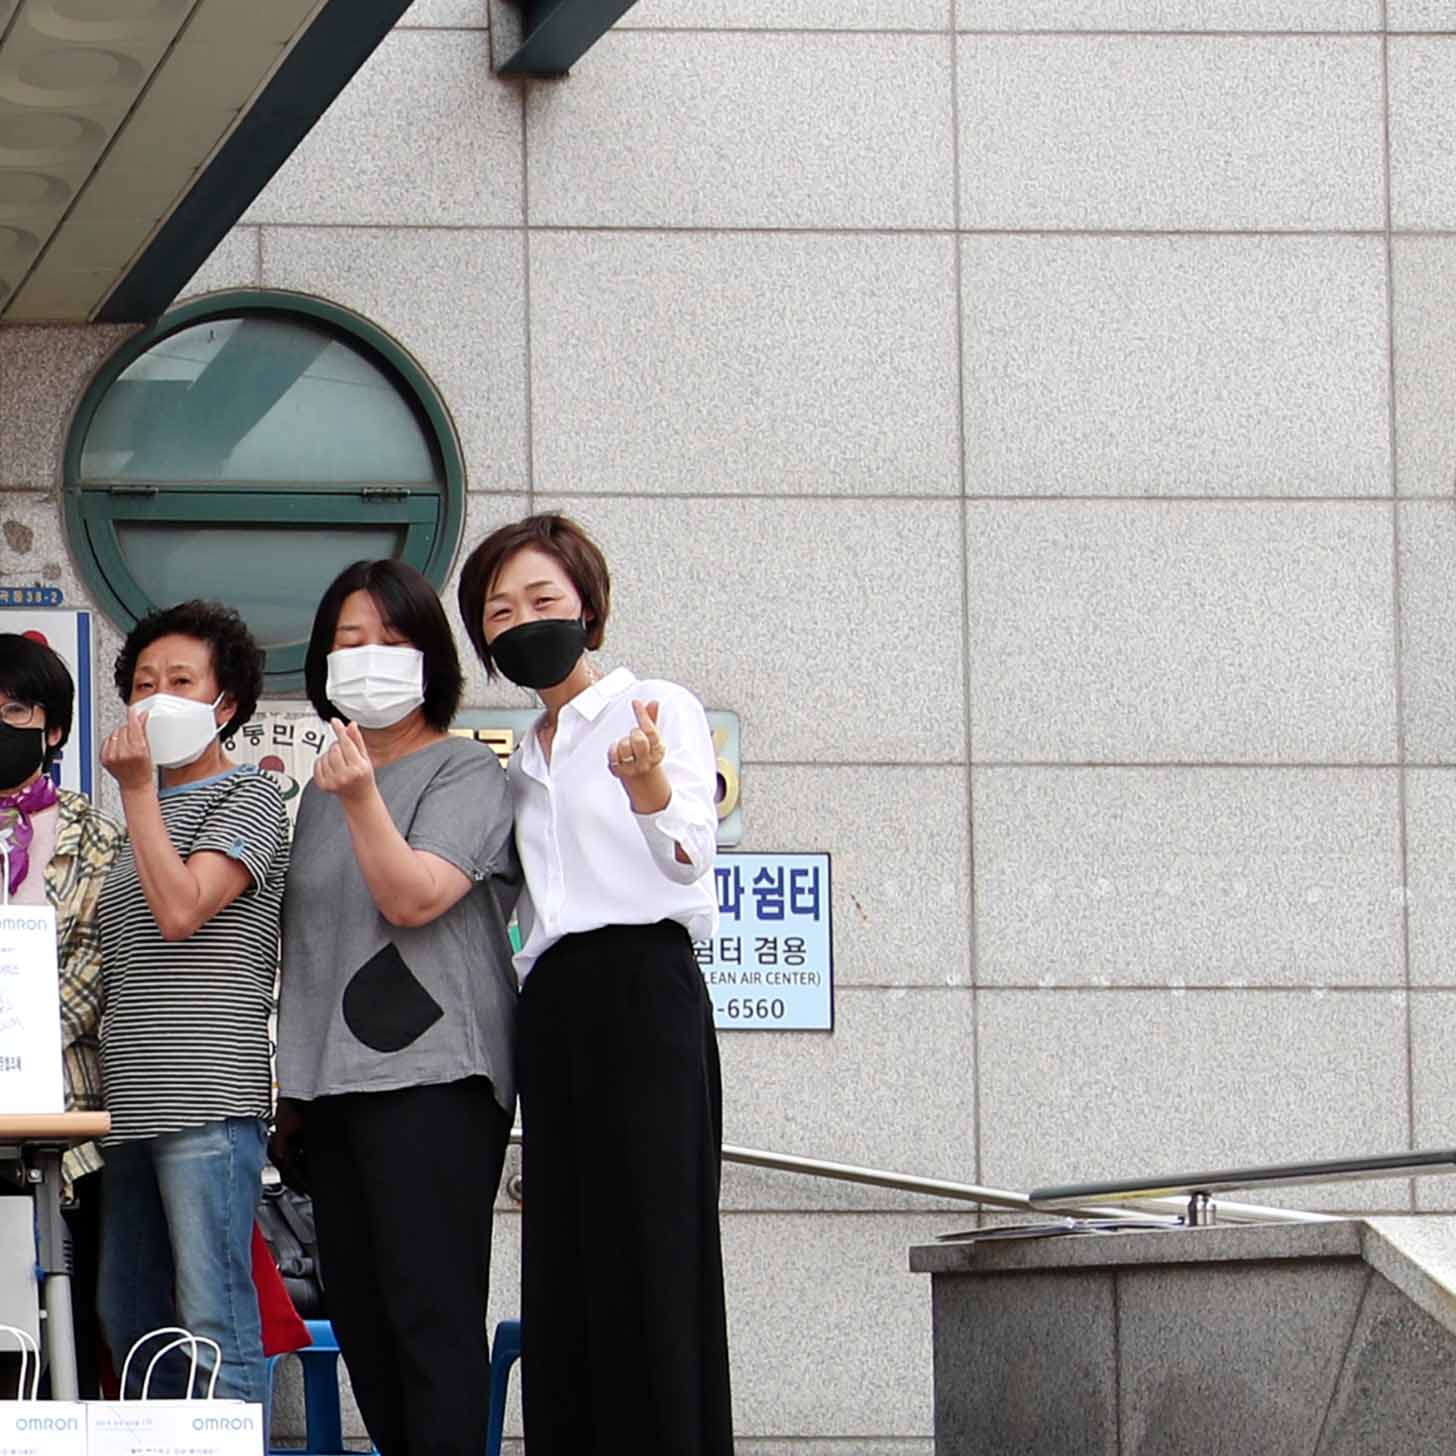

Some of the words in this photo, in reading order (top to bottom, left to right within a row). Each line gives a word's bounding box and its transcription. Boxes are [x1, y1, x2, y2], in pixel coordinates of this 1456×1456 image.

[752, 866, 820, 921] 쉼터
[754, 936, 806, 966] 겸용
[740, 971, 762, 985] AIR
[766, 971, 821, 986] CENTER)
[16, 1418, 78, 1431] OMRON
[192, 1418, 253, 1431] OMRON
